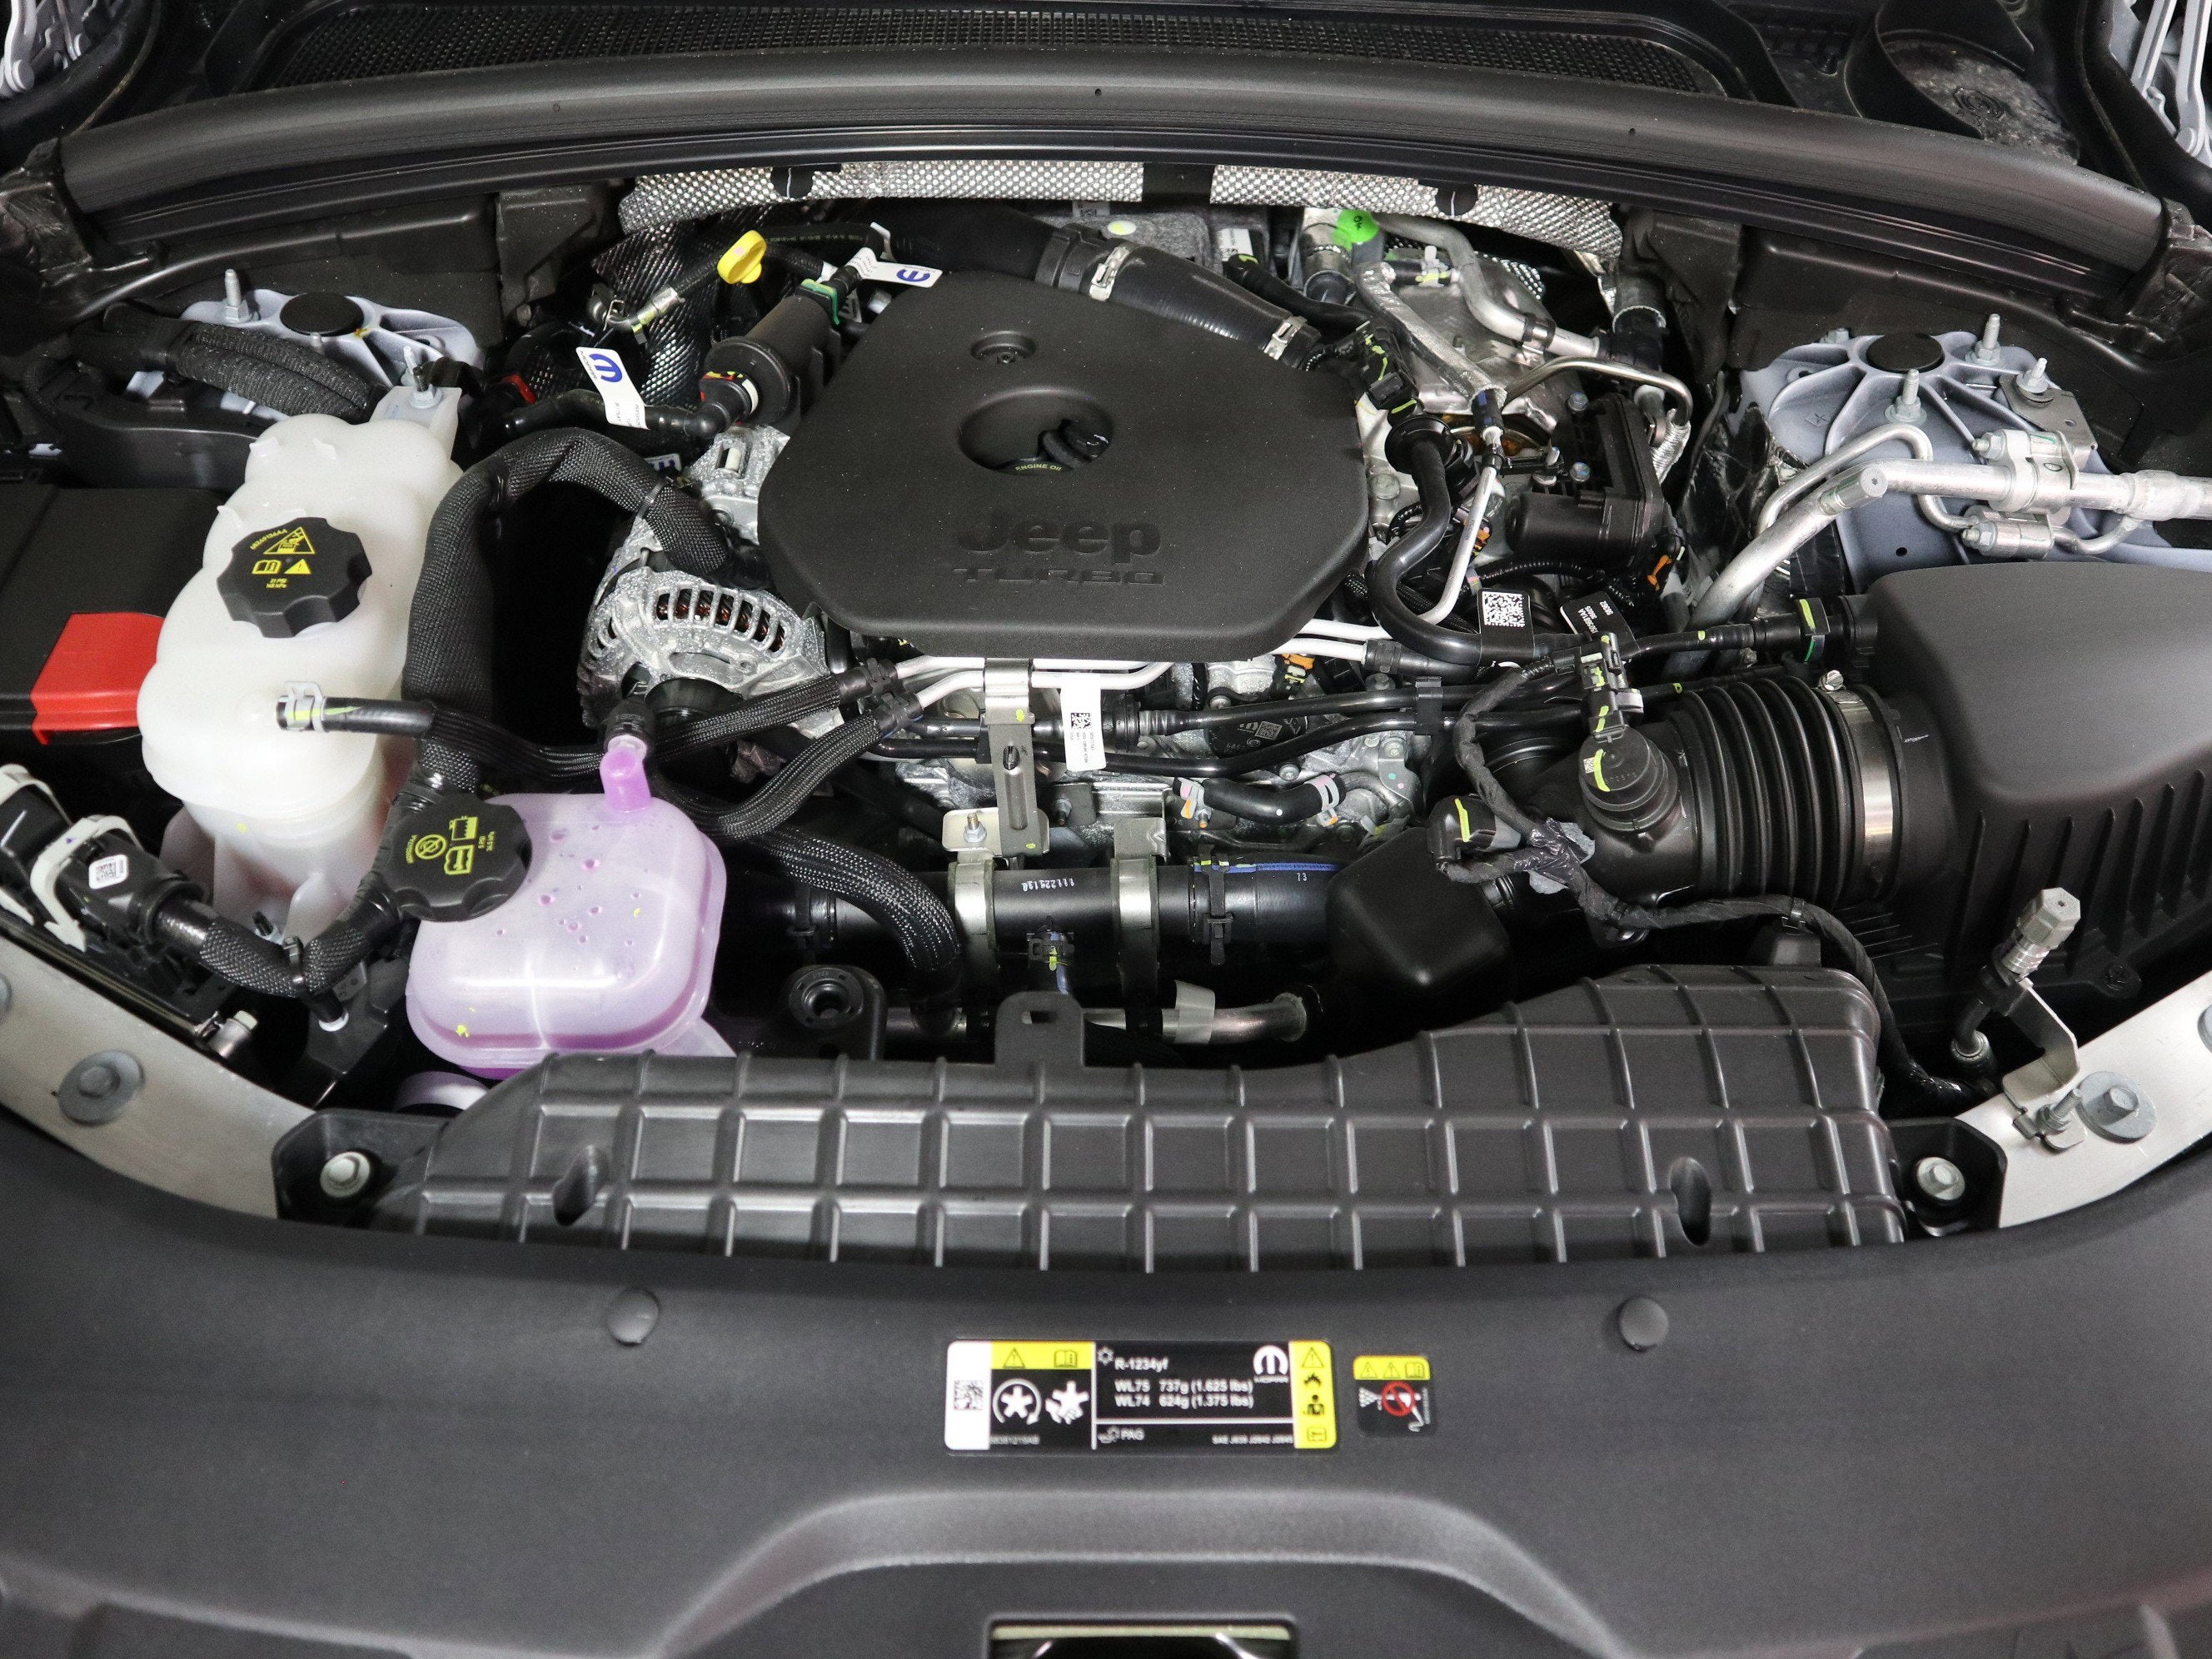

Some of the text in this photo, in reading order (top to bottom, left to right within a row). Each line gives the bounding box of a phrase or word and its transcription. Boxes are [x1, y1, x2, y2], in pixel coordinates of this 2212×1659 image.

[957, 510, 1162, 565] Jeep
[953, 567, 1165, 585] TURBO
[1114, 1357, 1169, 1373] R-1234yf
[1114, 1378, 1254, 1394] WL75 737g (1.625 lbs)
[1114, 1393, 1255, 1409] WL74 624g (1.375 lbs)
[1120, 1427, 1146, 1441] PAG
